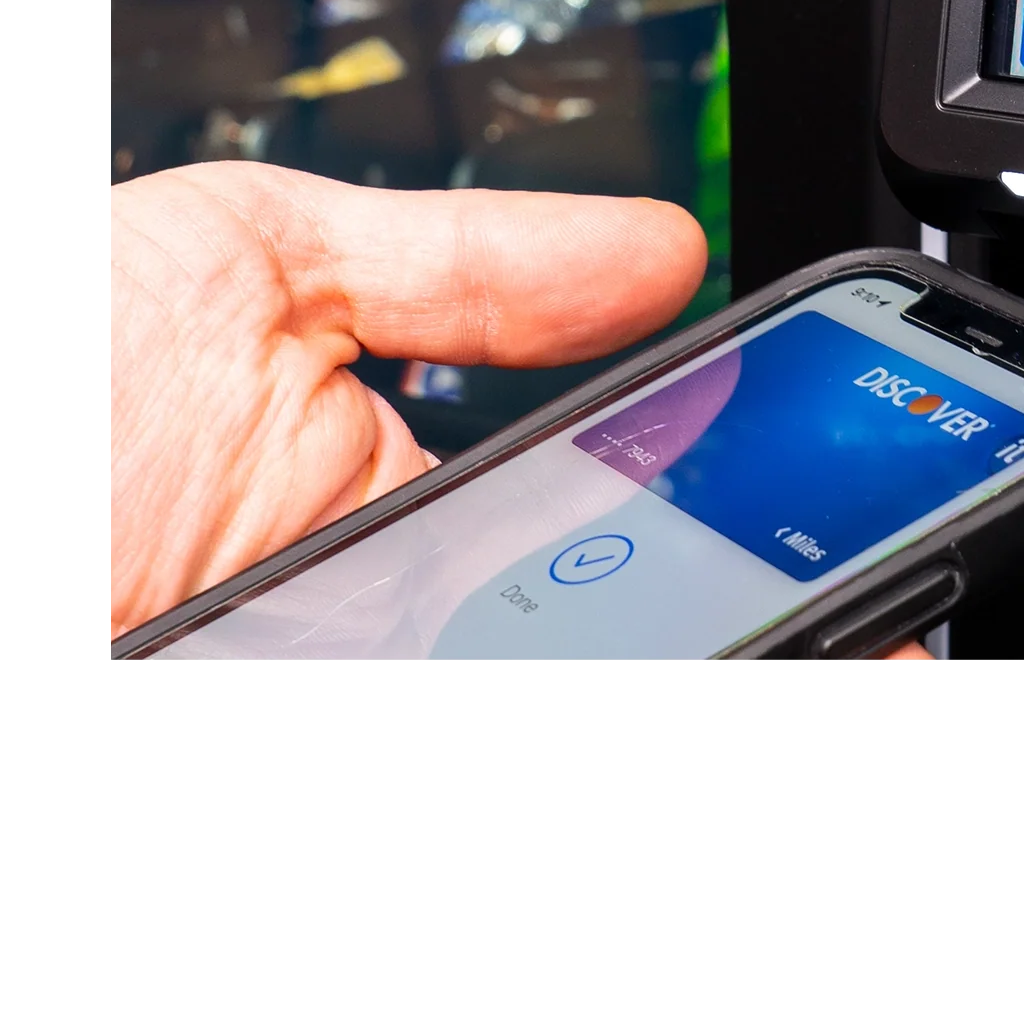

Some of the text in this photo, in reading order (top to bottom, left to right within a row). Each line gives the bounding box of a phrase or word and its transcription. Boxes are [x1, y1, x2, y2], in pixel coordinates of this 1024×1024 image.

[853, 367, 989, 441] DISCOVER
[782, 531, 827, 562] Miles
[500, 584, 539, 614] Done
